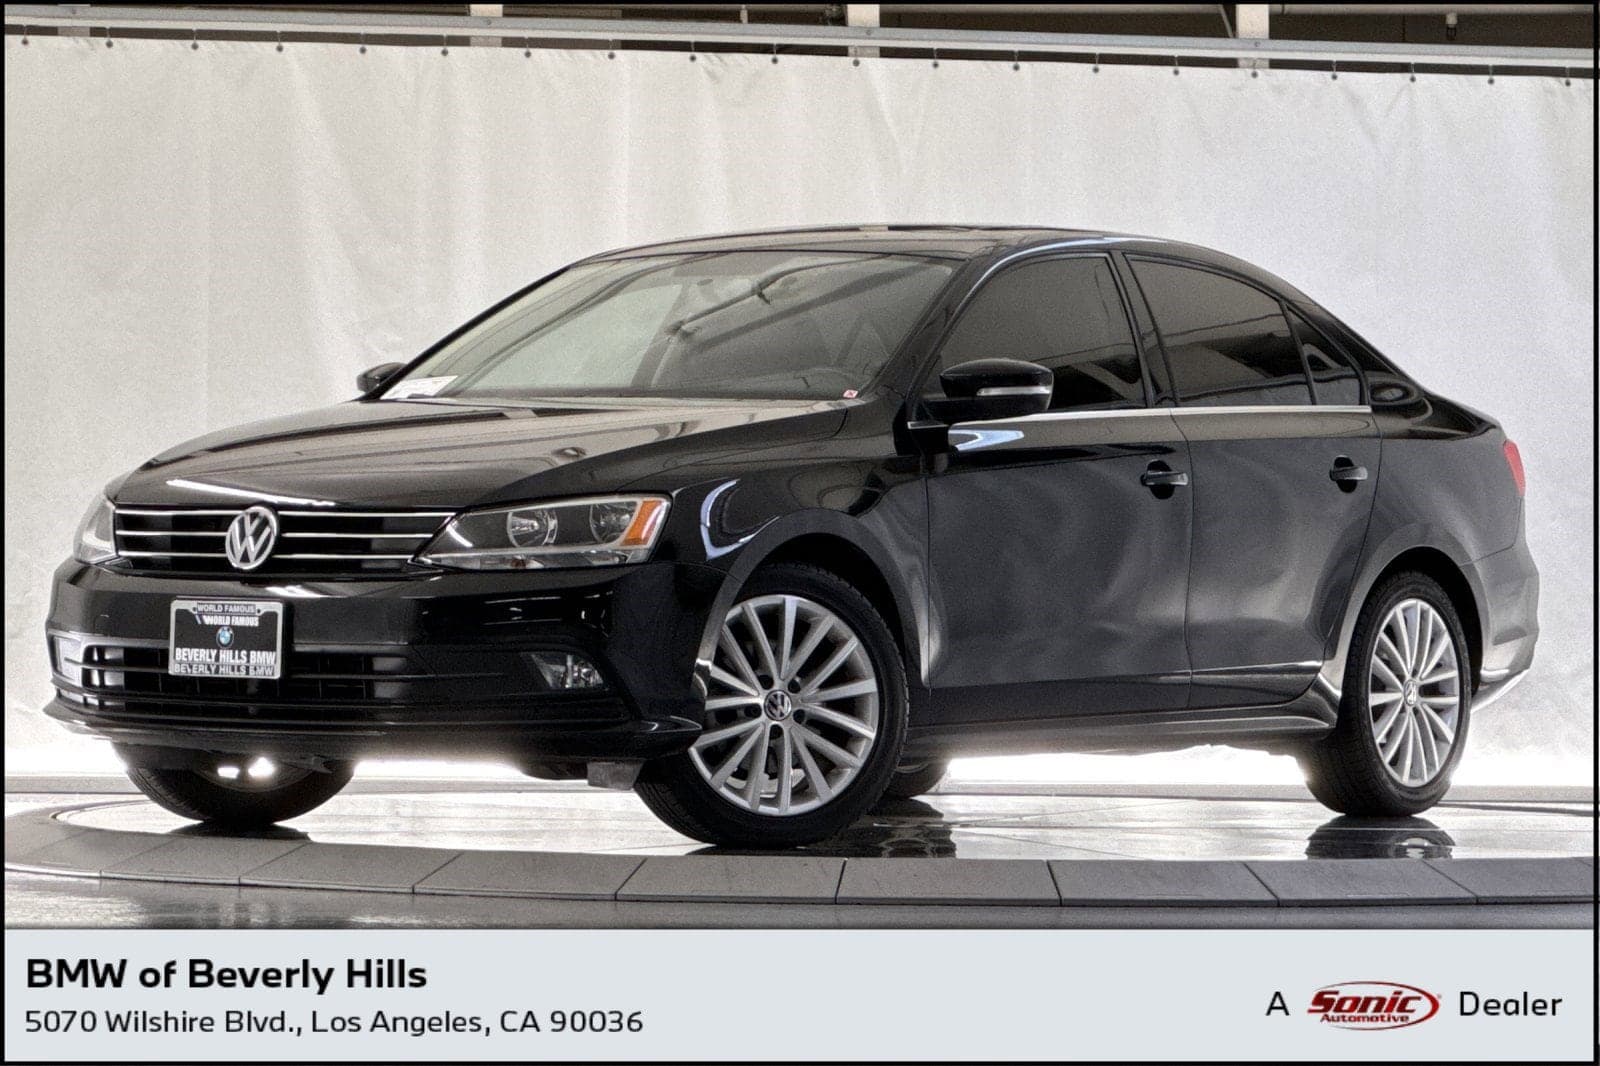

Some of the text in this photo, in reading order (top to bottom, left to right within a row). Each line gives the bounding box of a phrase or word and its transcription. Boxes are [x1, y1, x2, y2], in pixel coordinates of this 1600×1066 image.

[197, 604, 255, 613] WORLD FAMOUS
[202, 615, 259, 627] WORLD FAMOUS
[175, 647, 276, 665] BEVERLY HILLS BMW
[174, 663, 275, 676] BEVERLY HILLS BMW
